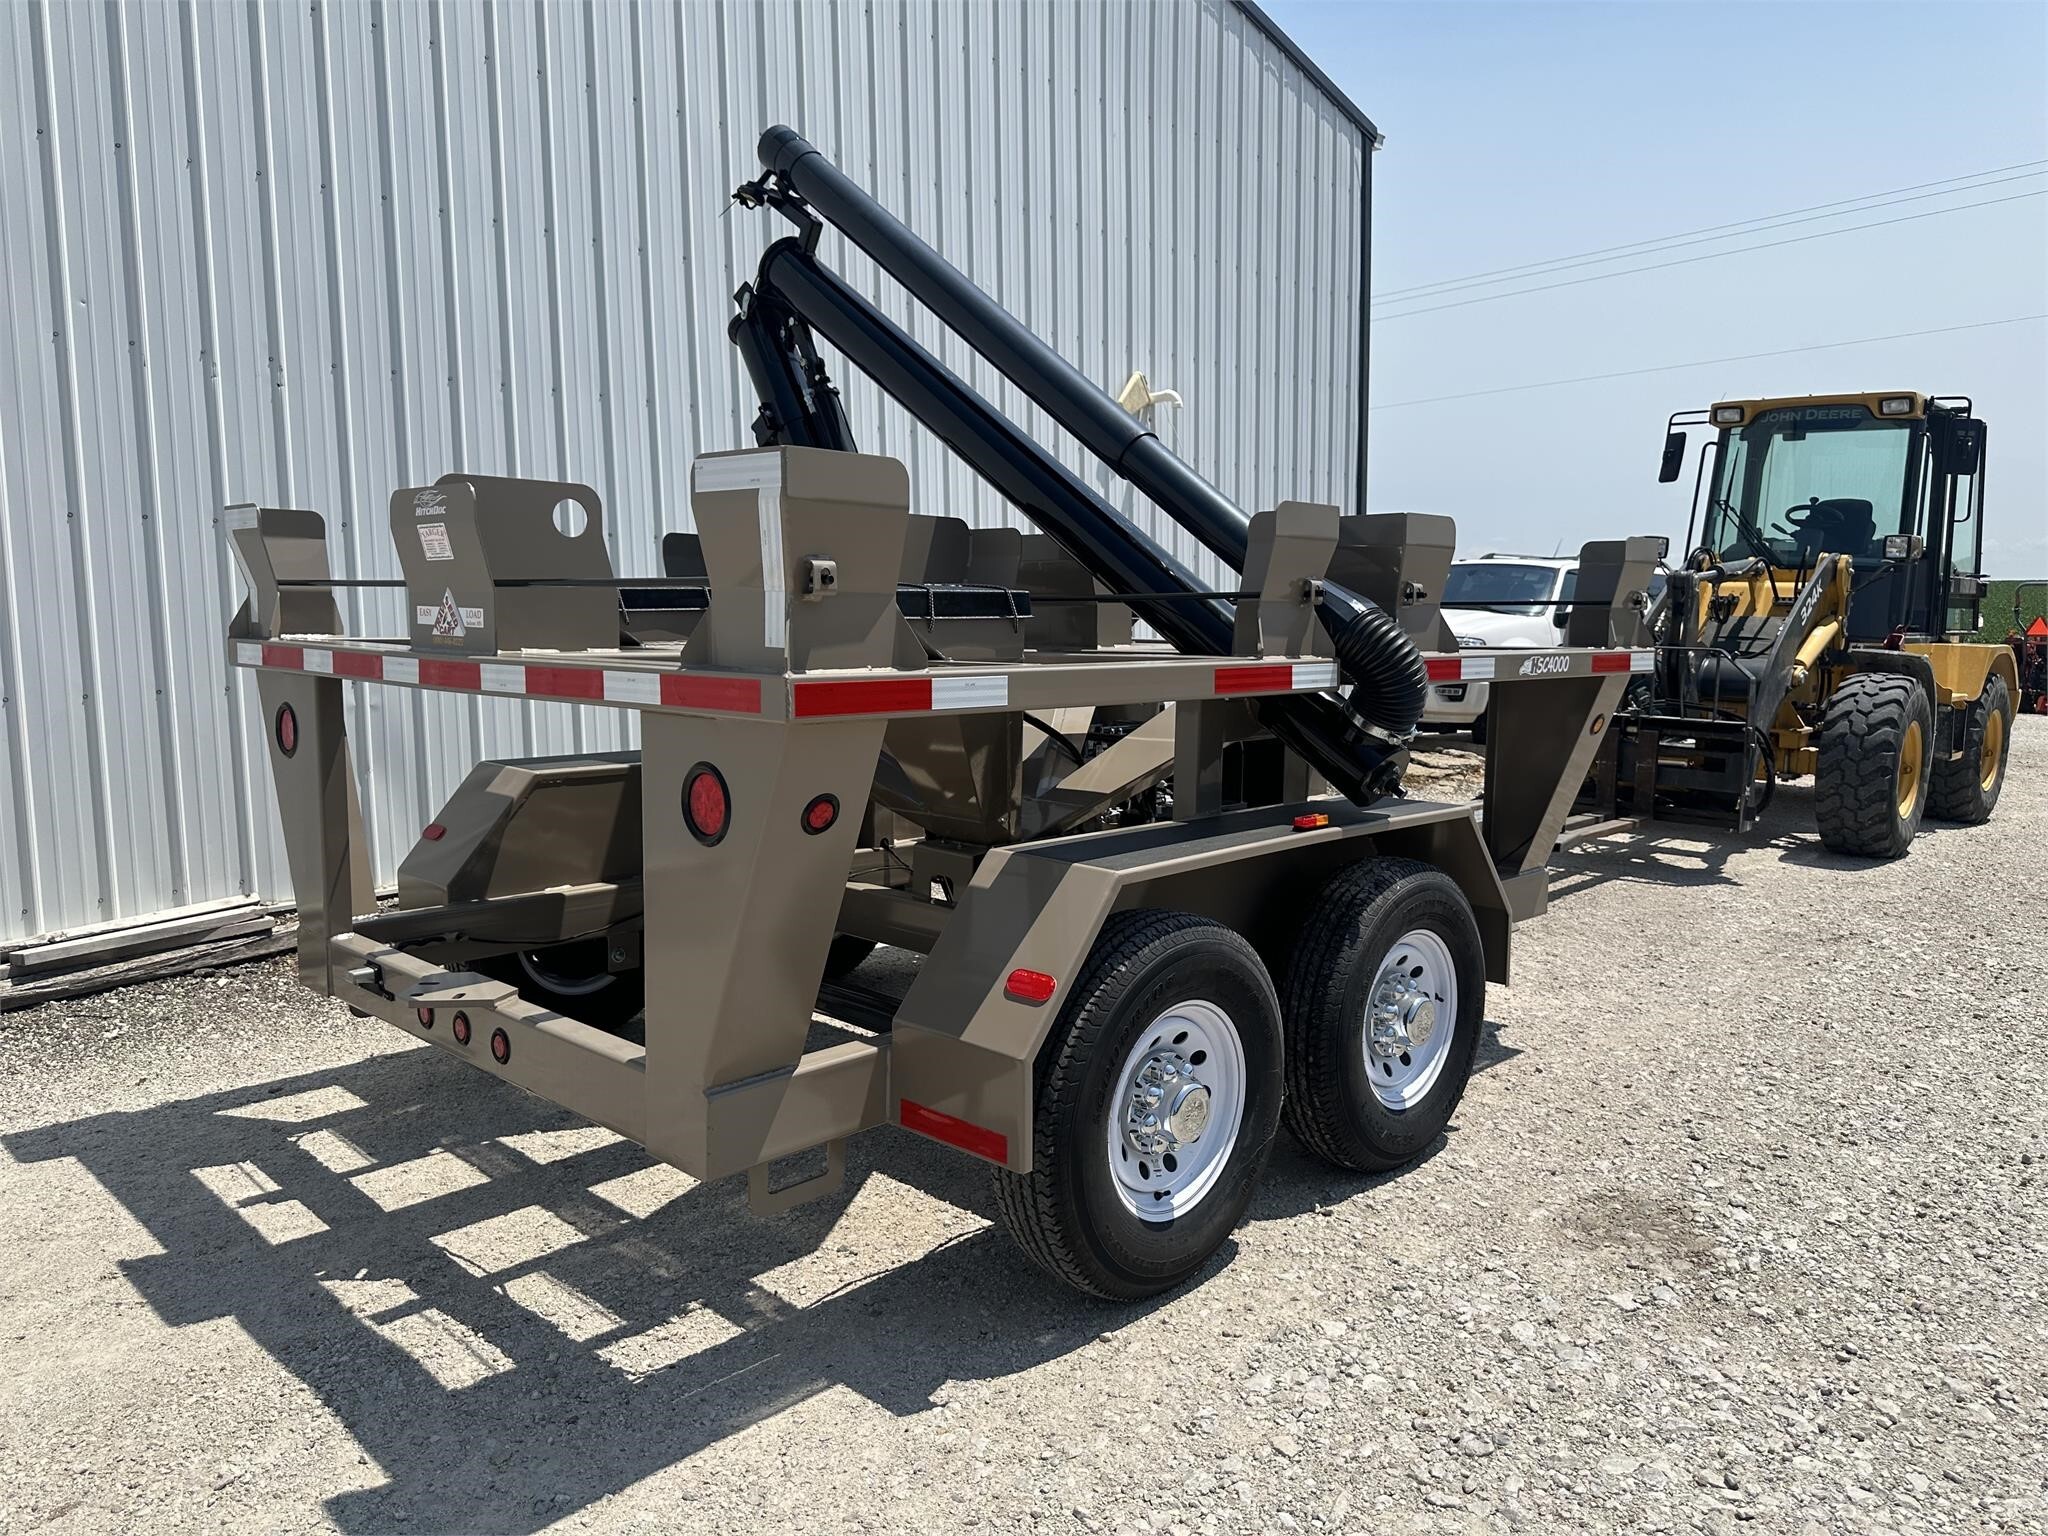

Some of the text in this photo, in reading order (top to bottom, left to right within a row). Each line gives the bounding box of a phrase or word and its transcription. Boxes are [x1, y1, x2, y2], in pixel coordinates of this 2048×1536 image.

[1760, 409, 1863, 423] JOHN DEERE
[1800, 578, 1823, 627] 324K
[419, 607, 433, 617] EASY
[465, 609, 482, 619] LOAD
[439, 626, 456, 636] CART
